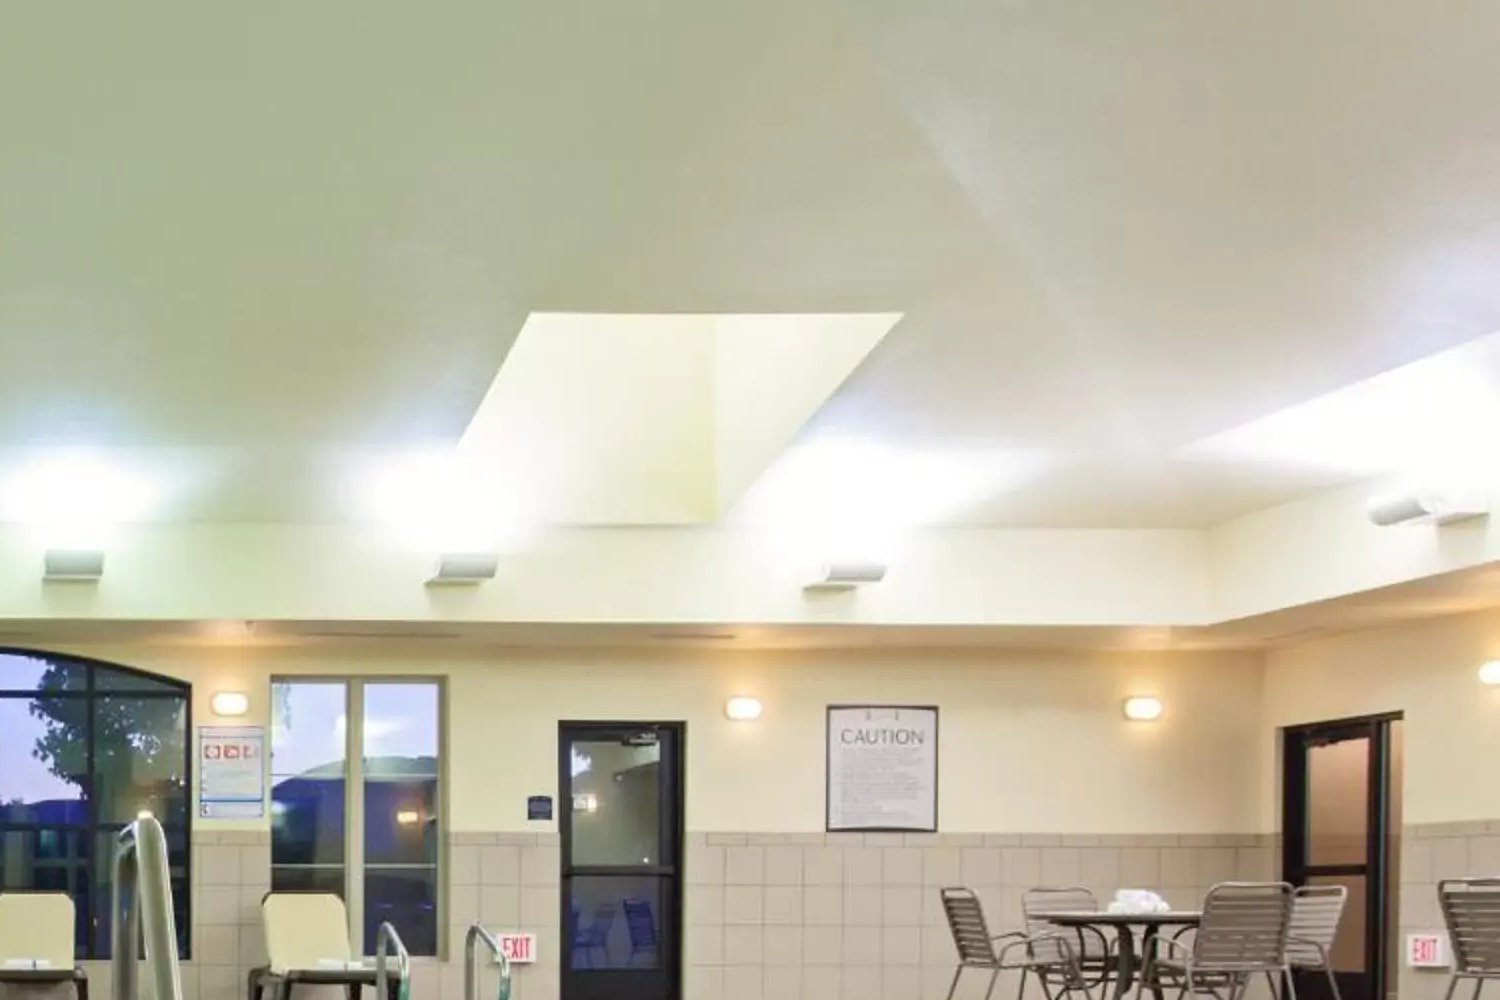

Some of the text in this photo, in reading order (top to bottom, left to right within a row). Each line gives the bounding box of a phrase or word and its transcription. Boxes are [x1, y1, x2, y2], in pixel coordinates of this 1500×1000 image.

[841, 728, 925, 745] CAUTION
[502, 937, 531, 959] EXIT
[1412, 938, 1438, 961] EXIT
